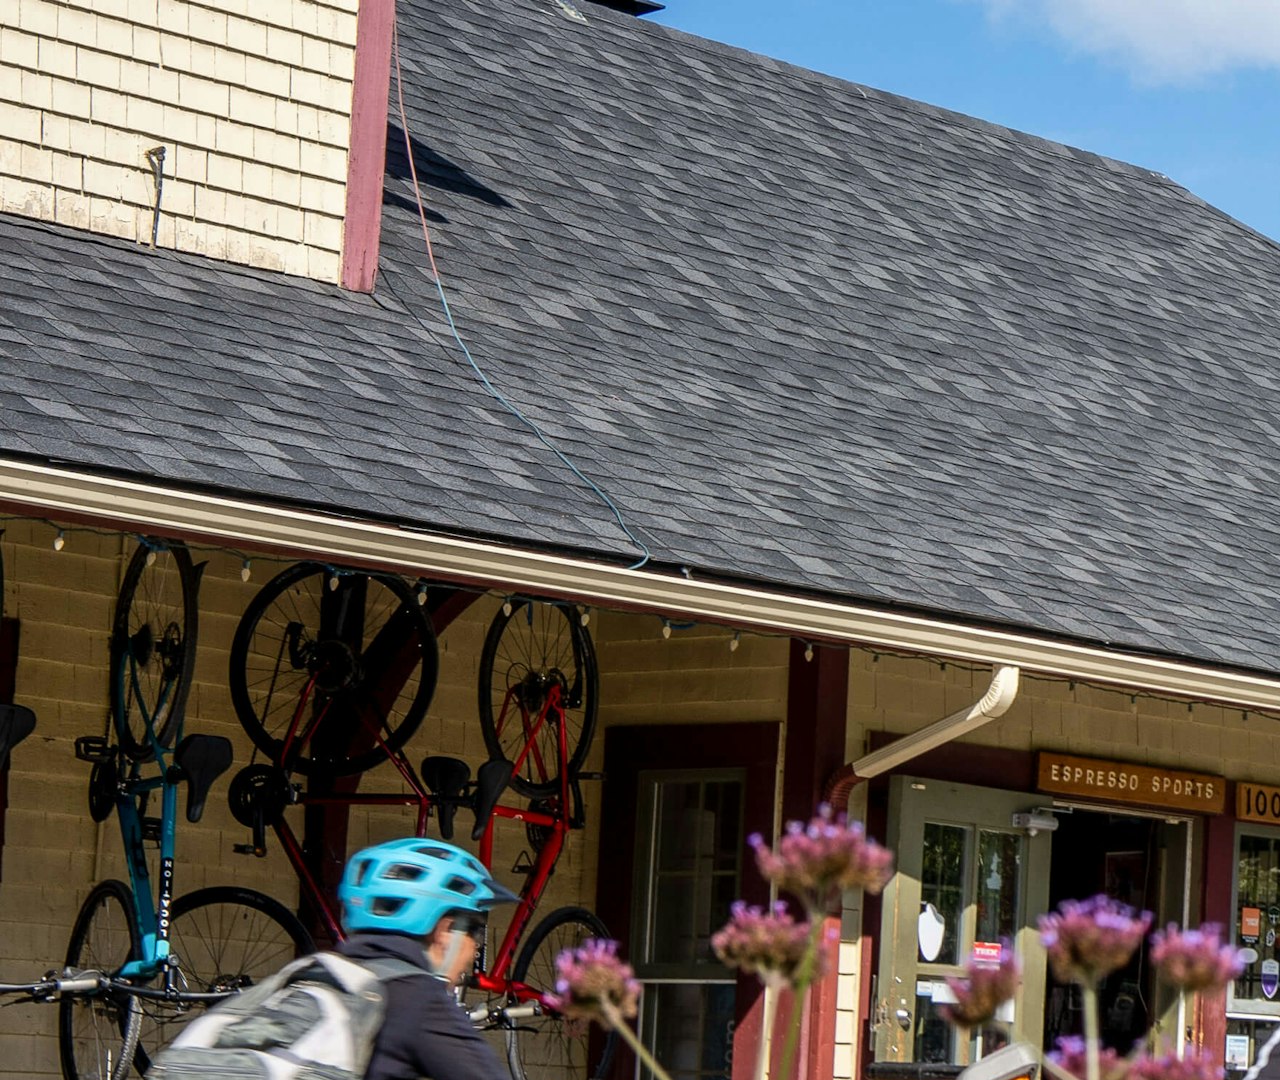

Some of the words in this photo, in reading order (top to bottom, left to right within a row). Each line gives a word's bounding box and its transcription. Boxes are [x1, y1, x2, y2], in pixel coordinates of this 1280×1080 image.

[1050, 763, 1139, 791] ESPRESSO
[1151, 775, 1215, 799] SPORTS
[160, 860, 173, 938] LOCATION
